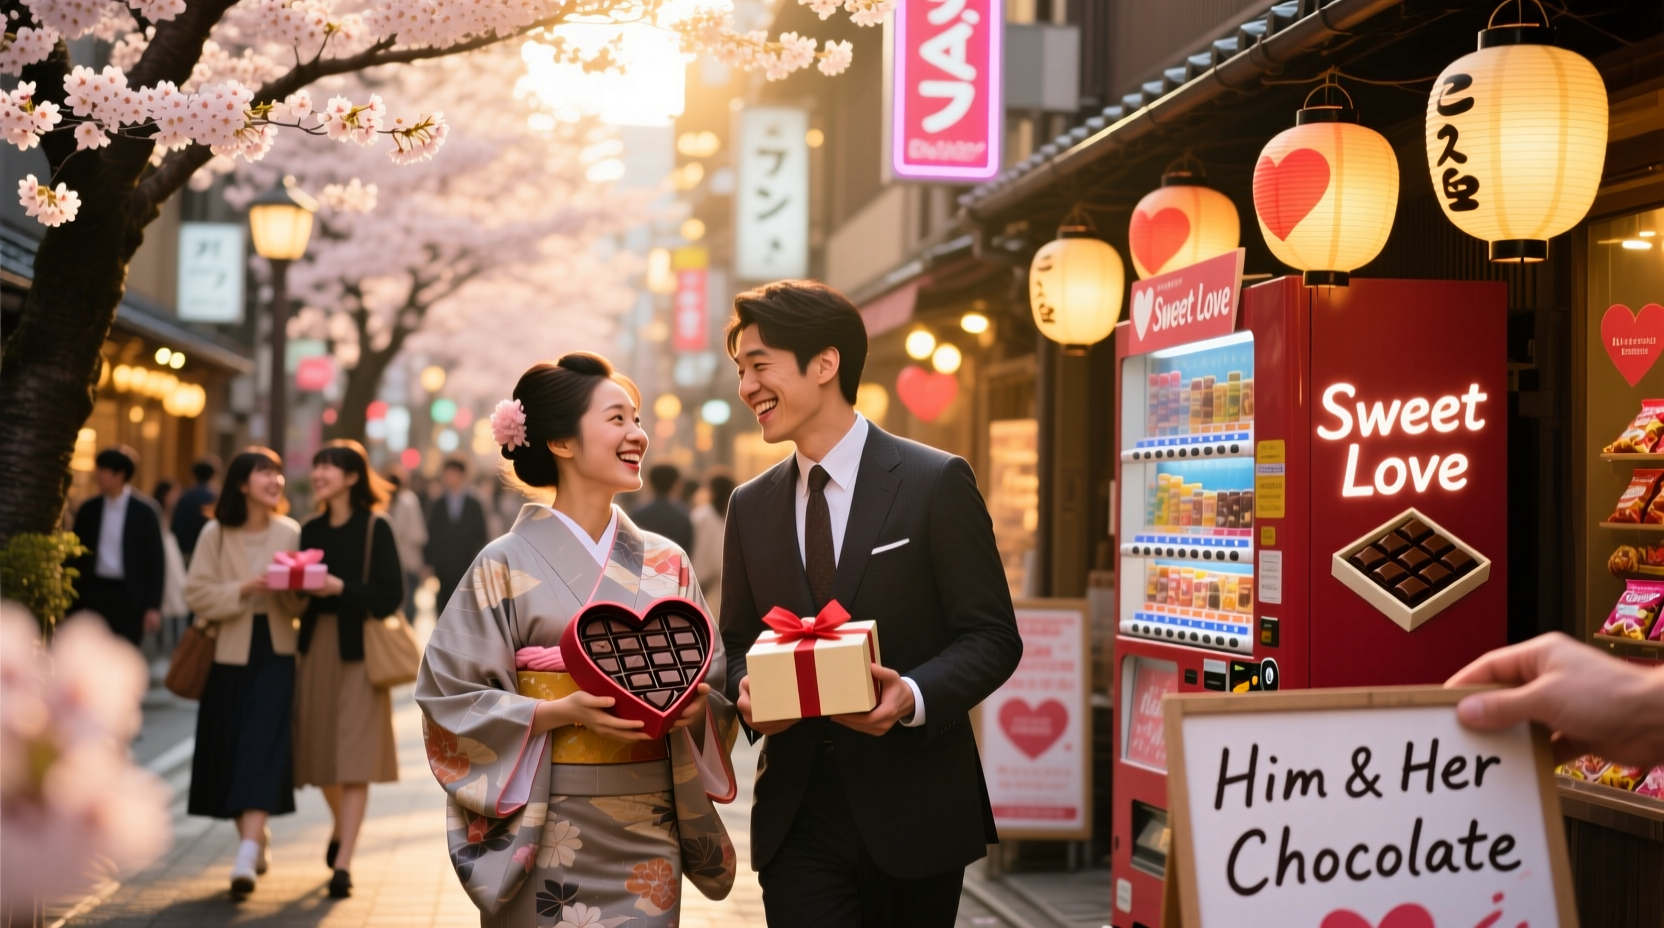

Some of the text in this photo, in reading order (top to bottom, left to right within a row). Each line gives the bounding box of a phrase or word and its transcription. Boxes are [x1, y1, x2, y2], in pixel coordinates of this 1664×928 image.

[1152, 283, 1231, 332] Sweet Love
[1317, 383, 1488, 440] Sweet
[1342, 443, 1468, 497] Love
[1214, 738, 1501, 810] Him & Her
[1226, 817, 1522, 896] Chocolate
